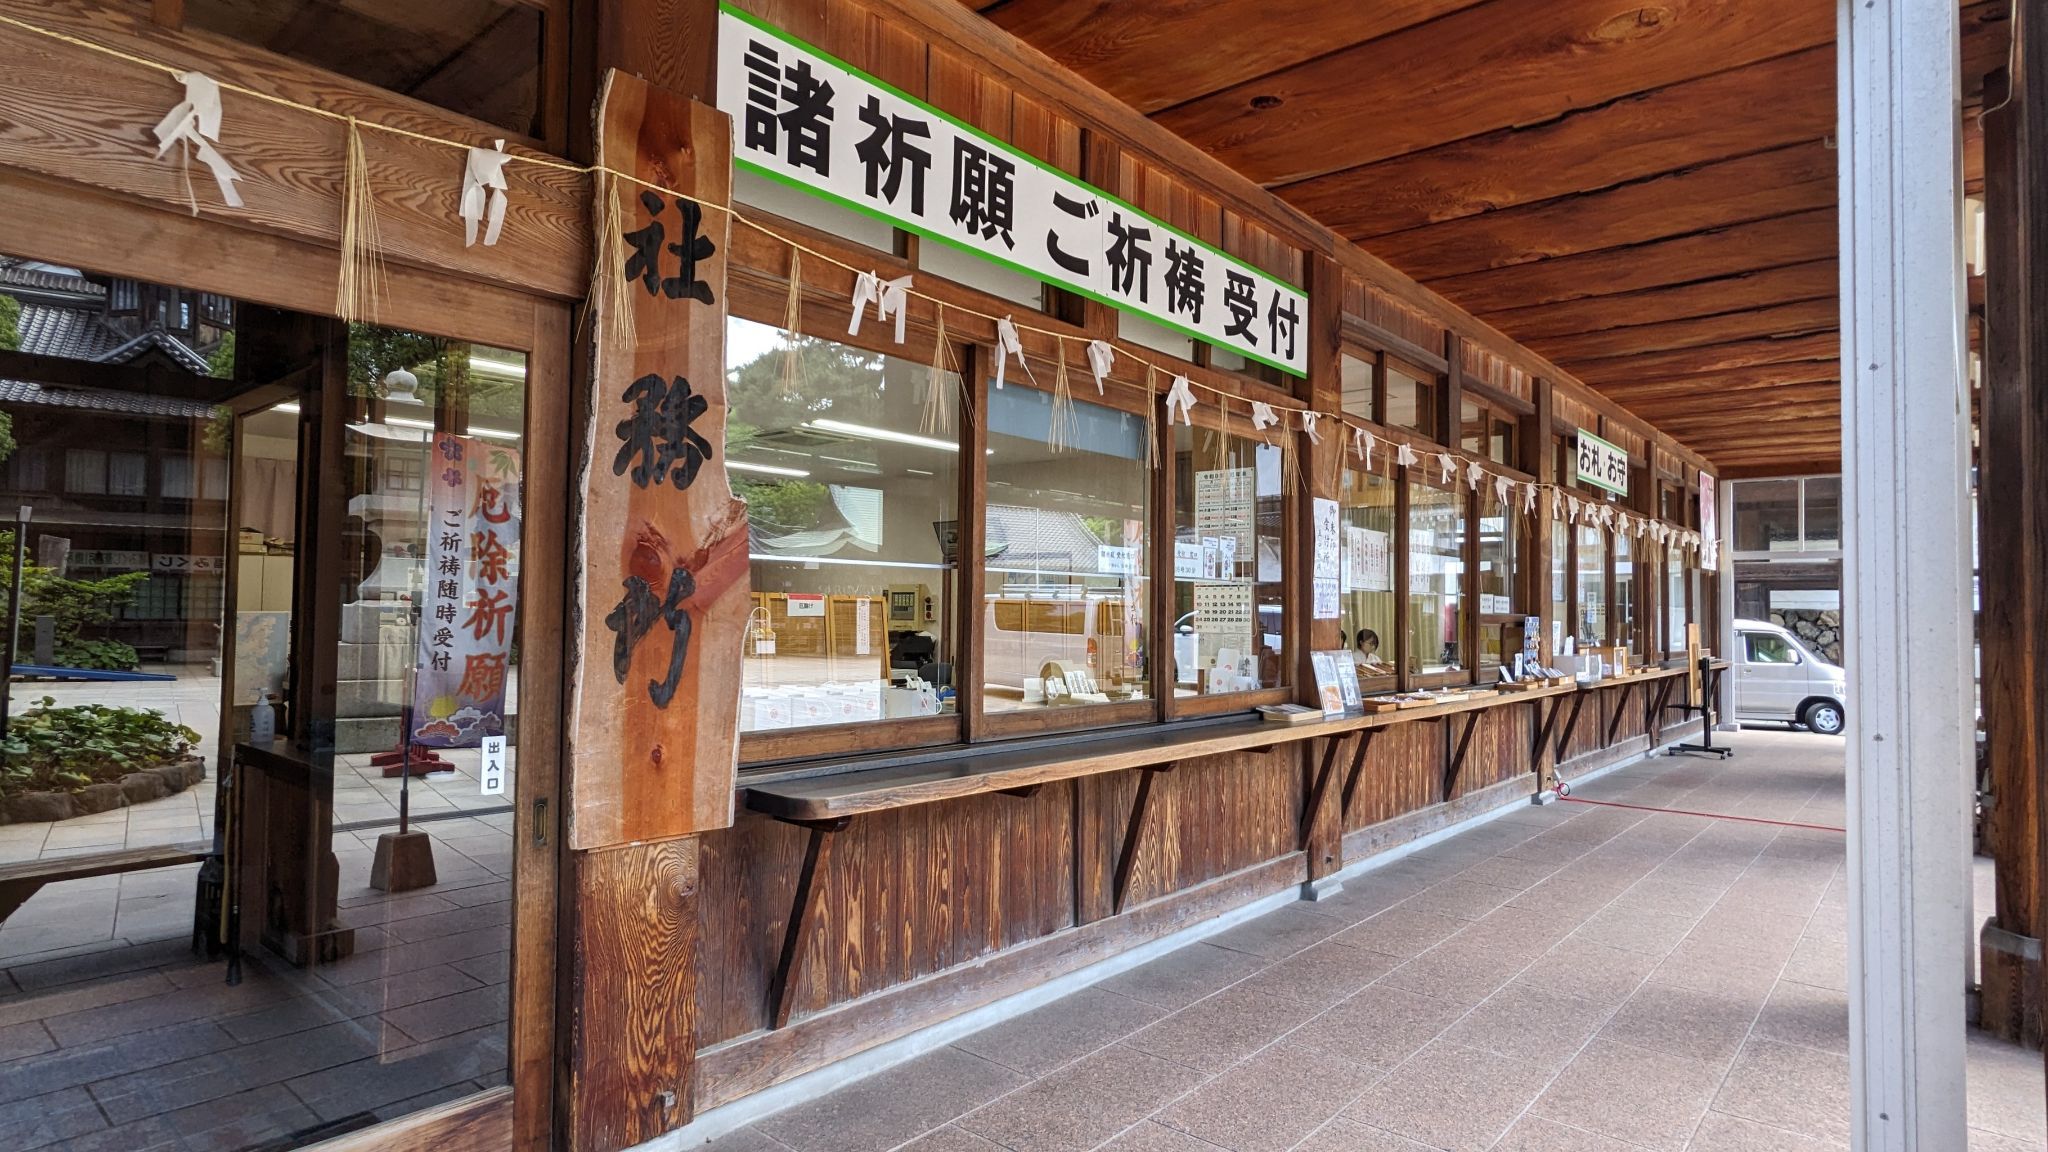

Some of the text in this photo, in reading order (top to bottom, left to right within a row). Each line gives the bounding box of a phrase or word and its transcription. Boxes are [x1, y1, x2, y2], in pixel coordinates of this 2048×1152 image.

[743, 38, 1016, 252] 諸祈願
[605, 189, 716, 710] 社務所
[1580, 439, 1626, 487] お札・お守
[431, 508, 463, 672] ご祈祷随時受付
[456, 474, 514, 702] 厄除祈願
[486, 741, 500, 790] 出入口
